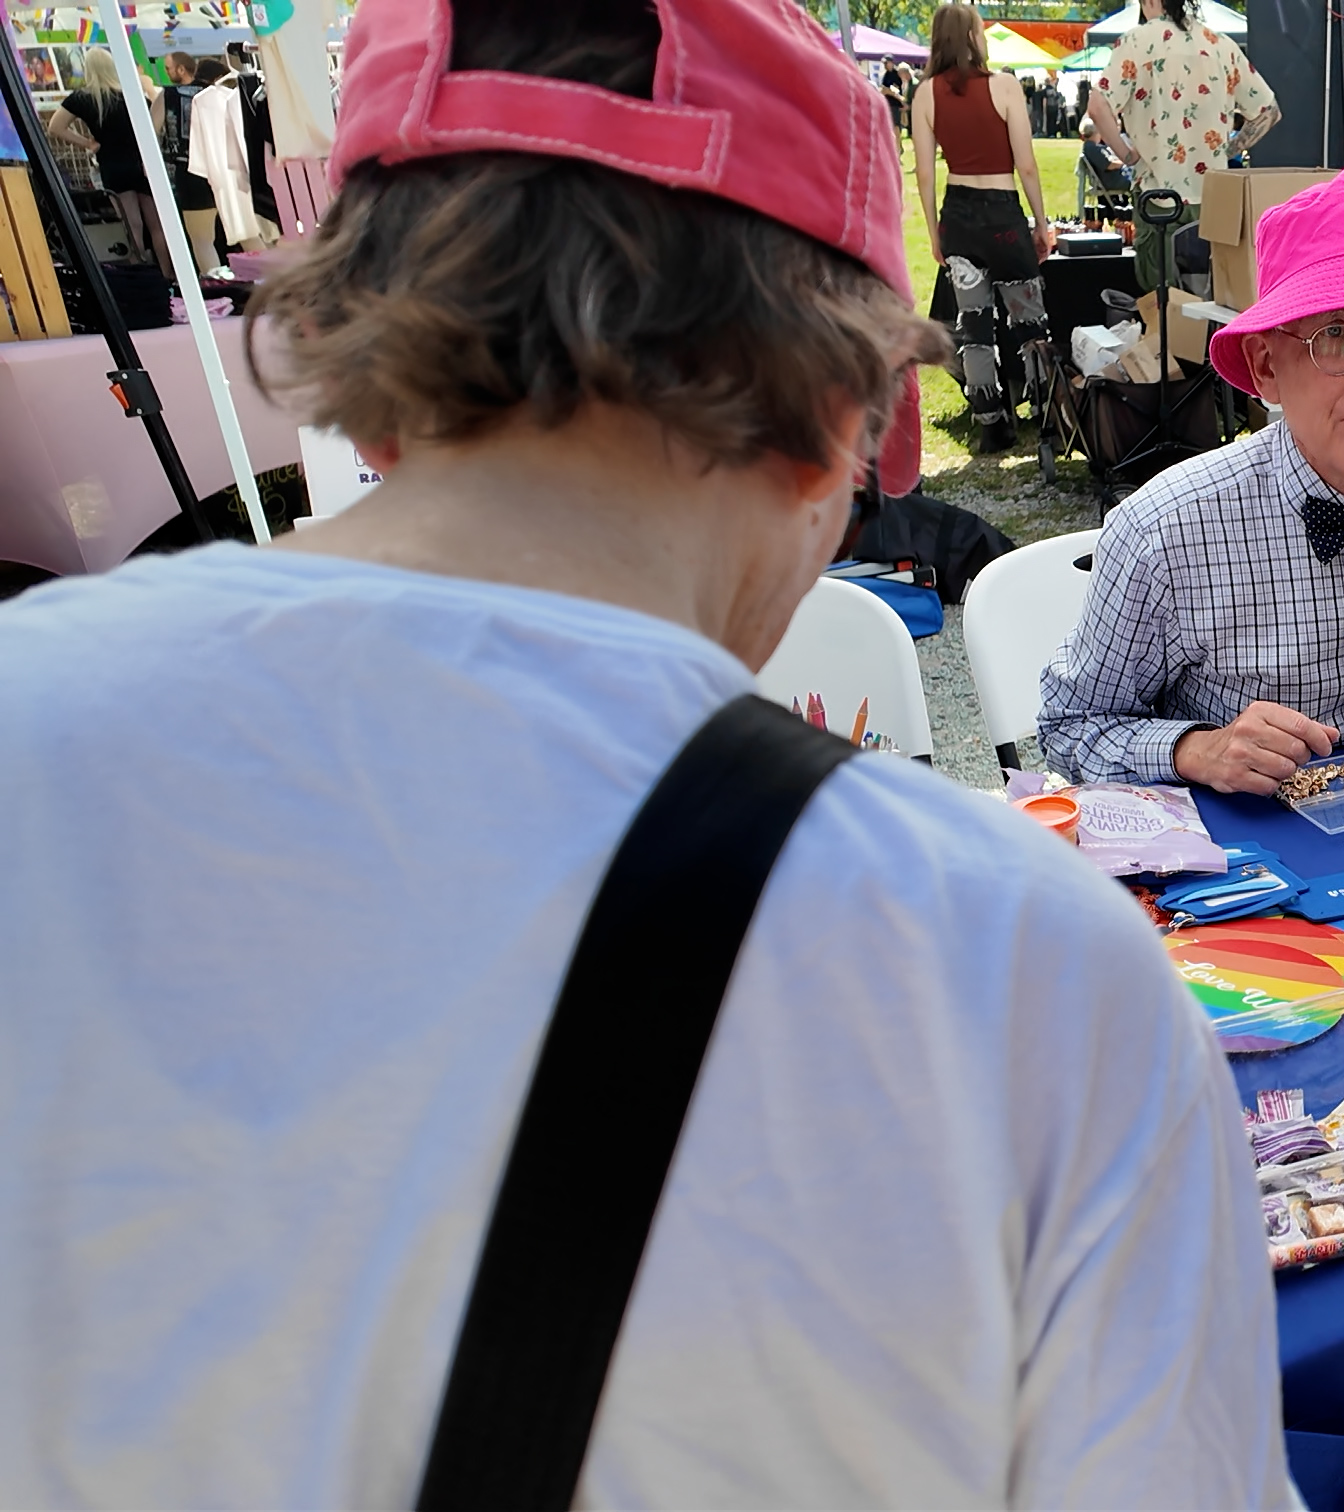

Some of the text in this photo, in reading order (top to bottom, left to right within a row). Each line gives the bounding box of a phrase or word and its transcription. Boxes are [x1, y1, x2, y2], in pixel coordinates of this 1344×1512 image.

[359, 472, 384, 484] RA
[1086, 816, 1164, 833] CREAMY
[1177, 959, 1236, 991] Love
